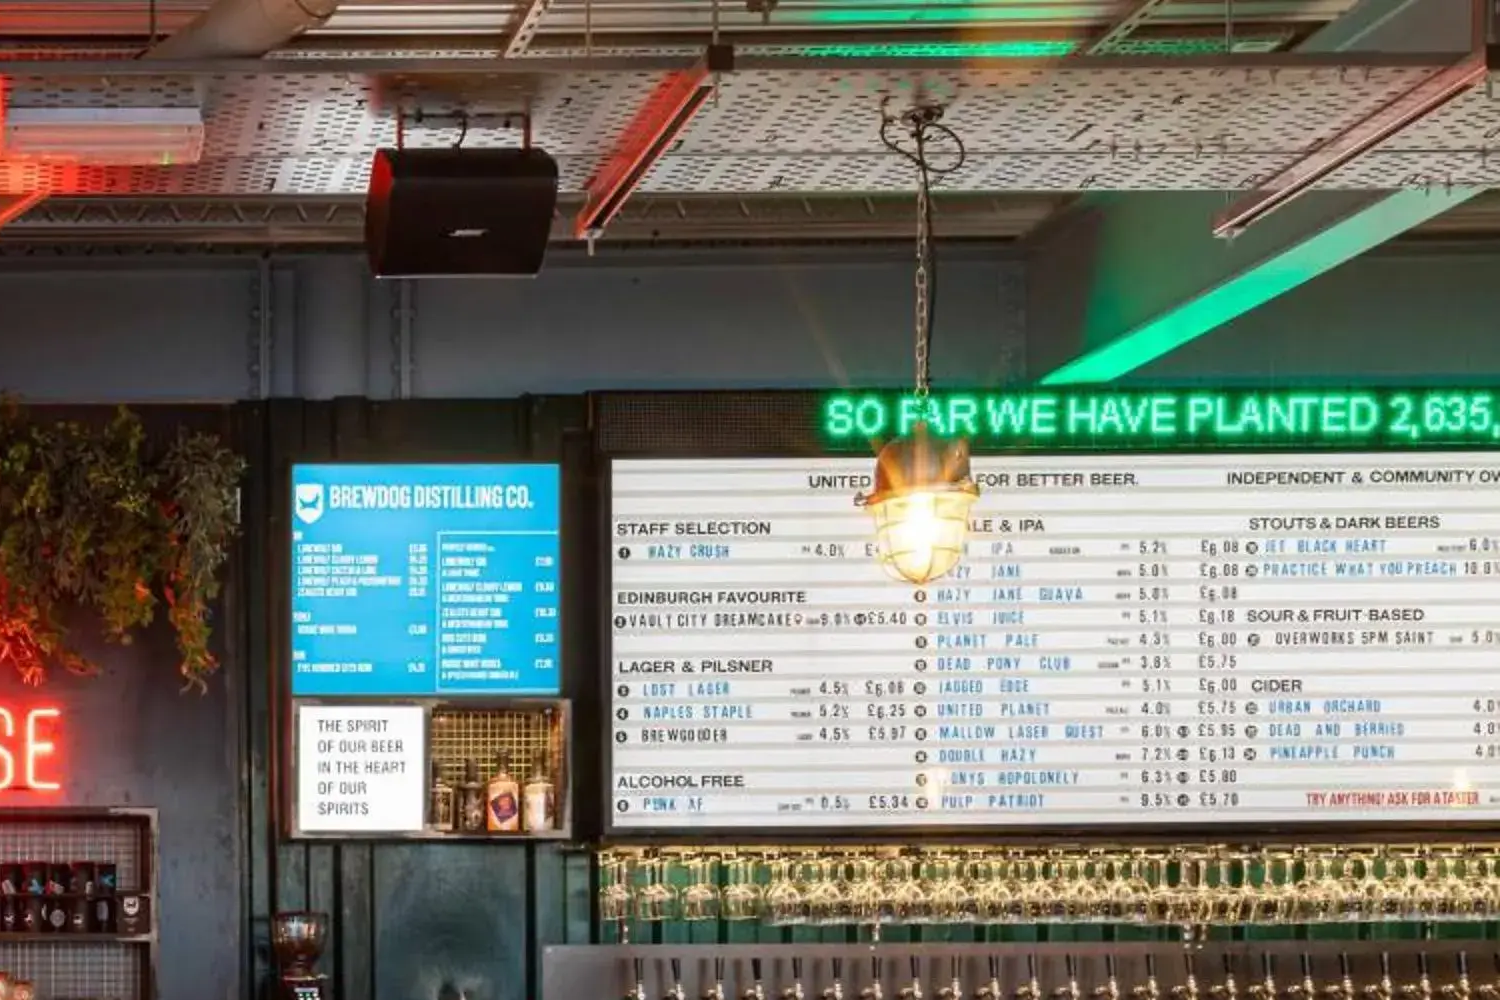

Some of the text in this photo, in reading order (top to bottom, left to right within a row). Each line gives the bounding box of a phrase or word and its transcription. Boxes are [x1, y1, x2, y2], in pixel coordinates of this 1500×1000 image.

[824, 396, 884, 436] SO
[900, 396, 976, 436] FAR
[987, 395, 1056, 434] WE
[1068, 395, 1176, 433] HAVE
[1187, 394, 1378, 434] PLANTED
[808, 472, 1139, 489] UNITED FOR BETTER BEER.
[1226, 469, 1476, 485] INDEPENDENT & COMMUNITY
[329, 484, 535, 509] BREWDOG DISTILLING CO.
[616, 521, 772, 536] STAFF SELECTION
[999, 519, 1012, 532] &
[1018, 518, 1045, 532] IPA
[1249, 515, 1441, 531] STOUTS & DARK BEERS
[689, 544, 731, 558] CRUSH
[1296, 539, 1338, 553] BLACK
[1344, 538, 1387, 553] HEART
[1263, 561, 1457, 577] PRACTICE WHAT YOU PREACH
[616, 590, 808, 606] EDINBURGH FAVOURITE
[936, 588, 972, 602] HAZY
[676, 613, 708, 627] CITY
[1246, 609, 1296, 623] SOUR
[1296, 609, 1310, 622] &
[936, 633, 987, 648] PLANET
[1274, 631, 1355, 645] OVERWORKS
[1394, 631, 1435, 644] SAINT
[618, 659, 774, 674] LAGER & PILSNER
[937, 658, 972, 671] DEAD
[986, 657, 1021, 671] PONY
[1039, 656, 1071, 671] CLUB
[1251, 679, 1303, 693] CIDER
[643, 706, 694, 720] NAPLES
[703, 705, 753, 719] STAPLE
[936, 703, 983, 717] UNITED
[1000, 702, 1050, 717] PLANET
[1268, 699, 1382, 714] URBAN ORCHARD
[317, 719, 389, 733] THE SPIRIT
[938, 725, 996, 740] MALLOW
[1007, 725, 1049, 739] LASER
[1268, 723, 1302, 738] DEAD
[317, 739, 404, 754] OF OUR BEER
[1000, 748, 1037, 763] HAZY
[317, 760, 406, 775] IN THE HEART
[317, 780, 367, 796] OF OUR
[617, 774, 745, 789] ALCOHOL FREE
[988, 793, 1044, 808] PATRIOT
[1306, 792, 1328, 806] TRY
[317, 801, 370, 816] SPIRITS
